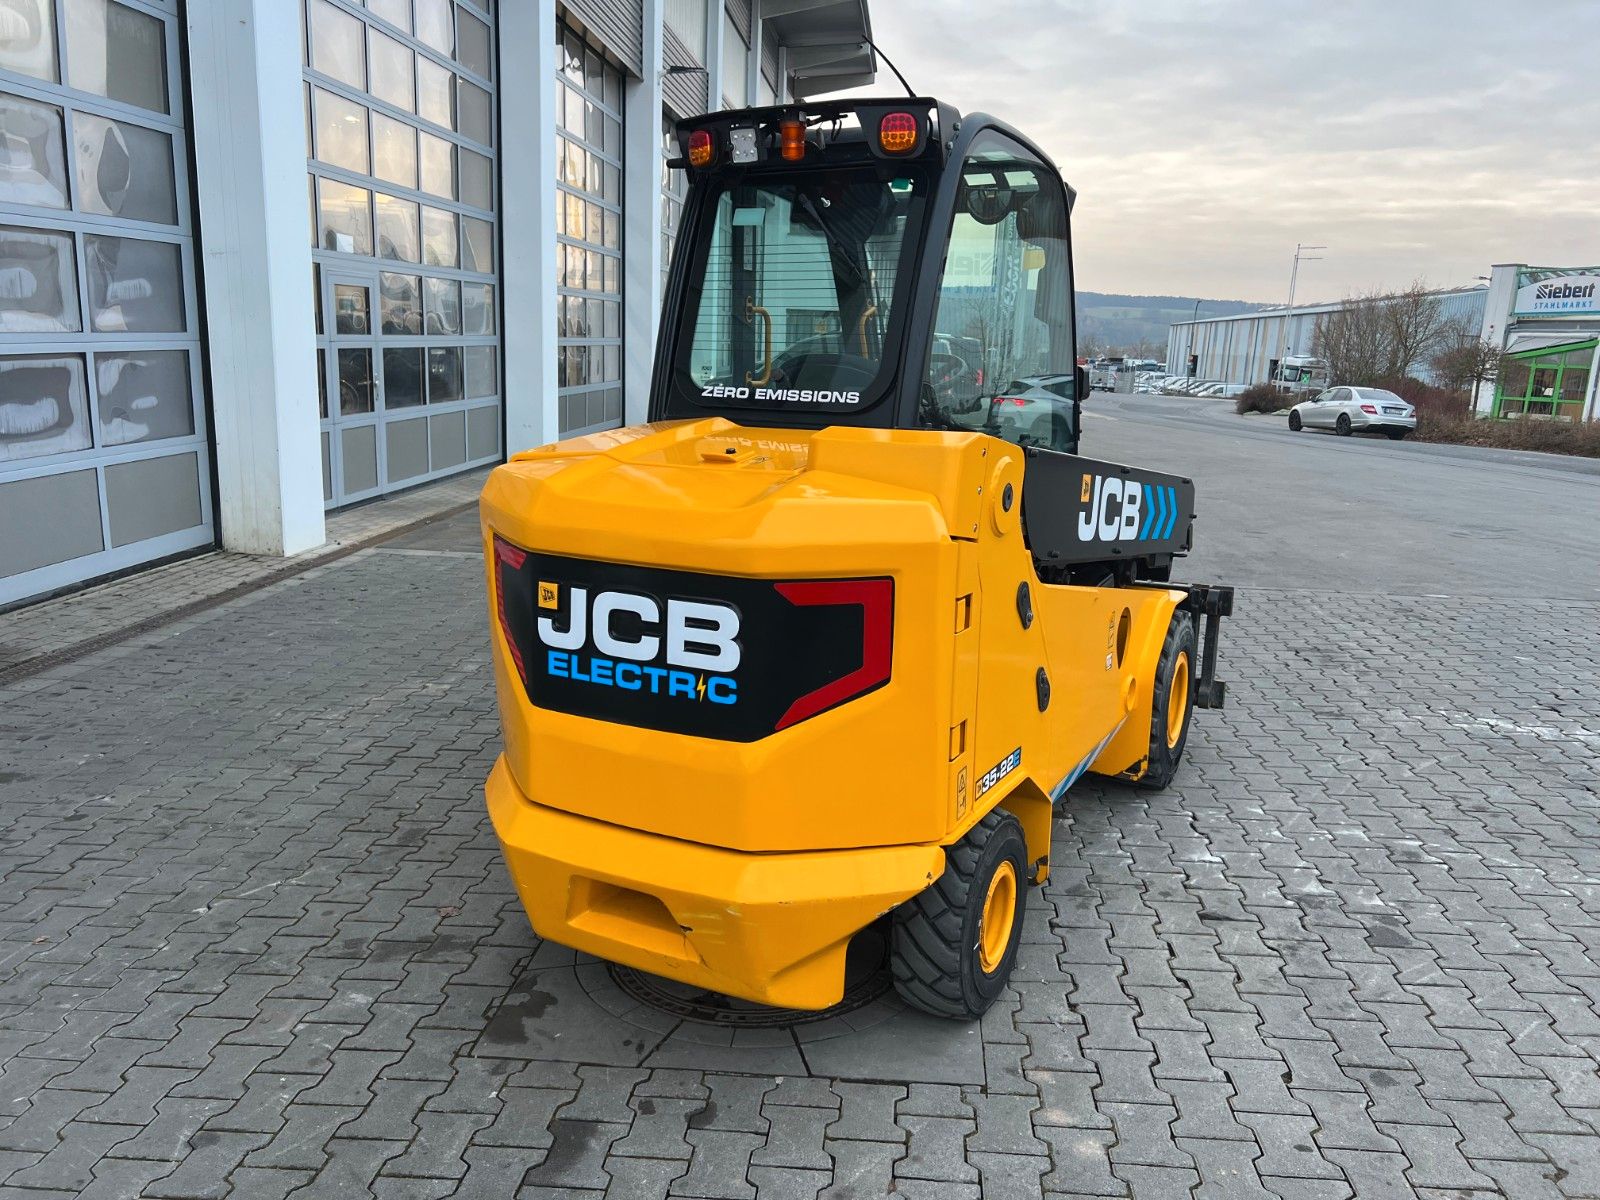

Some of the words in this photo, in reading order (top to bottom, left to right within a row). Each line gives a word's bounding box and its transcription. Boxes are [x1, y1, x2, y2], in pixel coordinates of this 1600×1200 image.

[1534, 301, 1593, 309] STAHLMARKT
[1535, 283, 1596, 299] Siebert
[701, 386, 749, 399] ZERO
[754, 388, 860, 404] EMISSIONS
[1078, 474, 1142, 542] JCB
[537, 586, 741, 673] JCB
[548, 650, 737, 705] ELECTRIC
